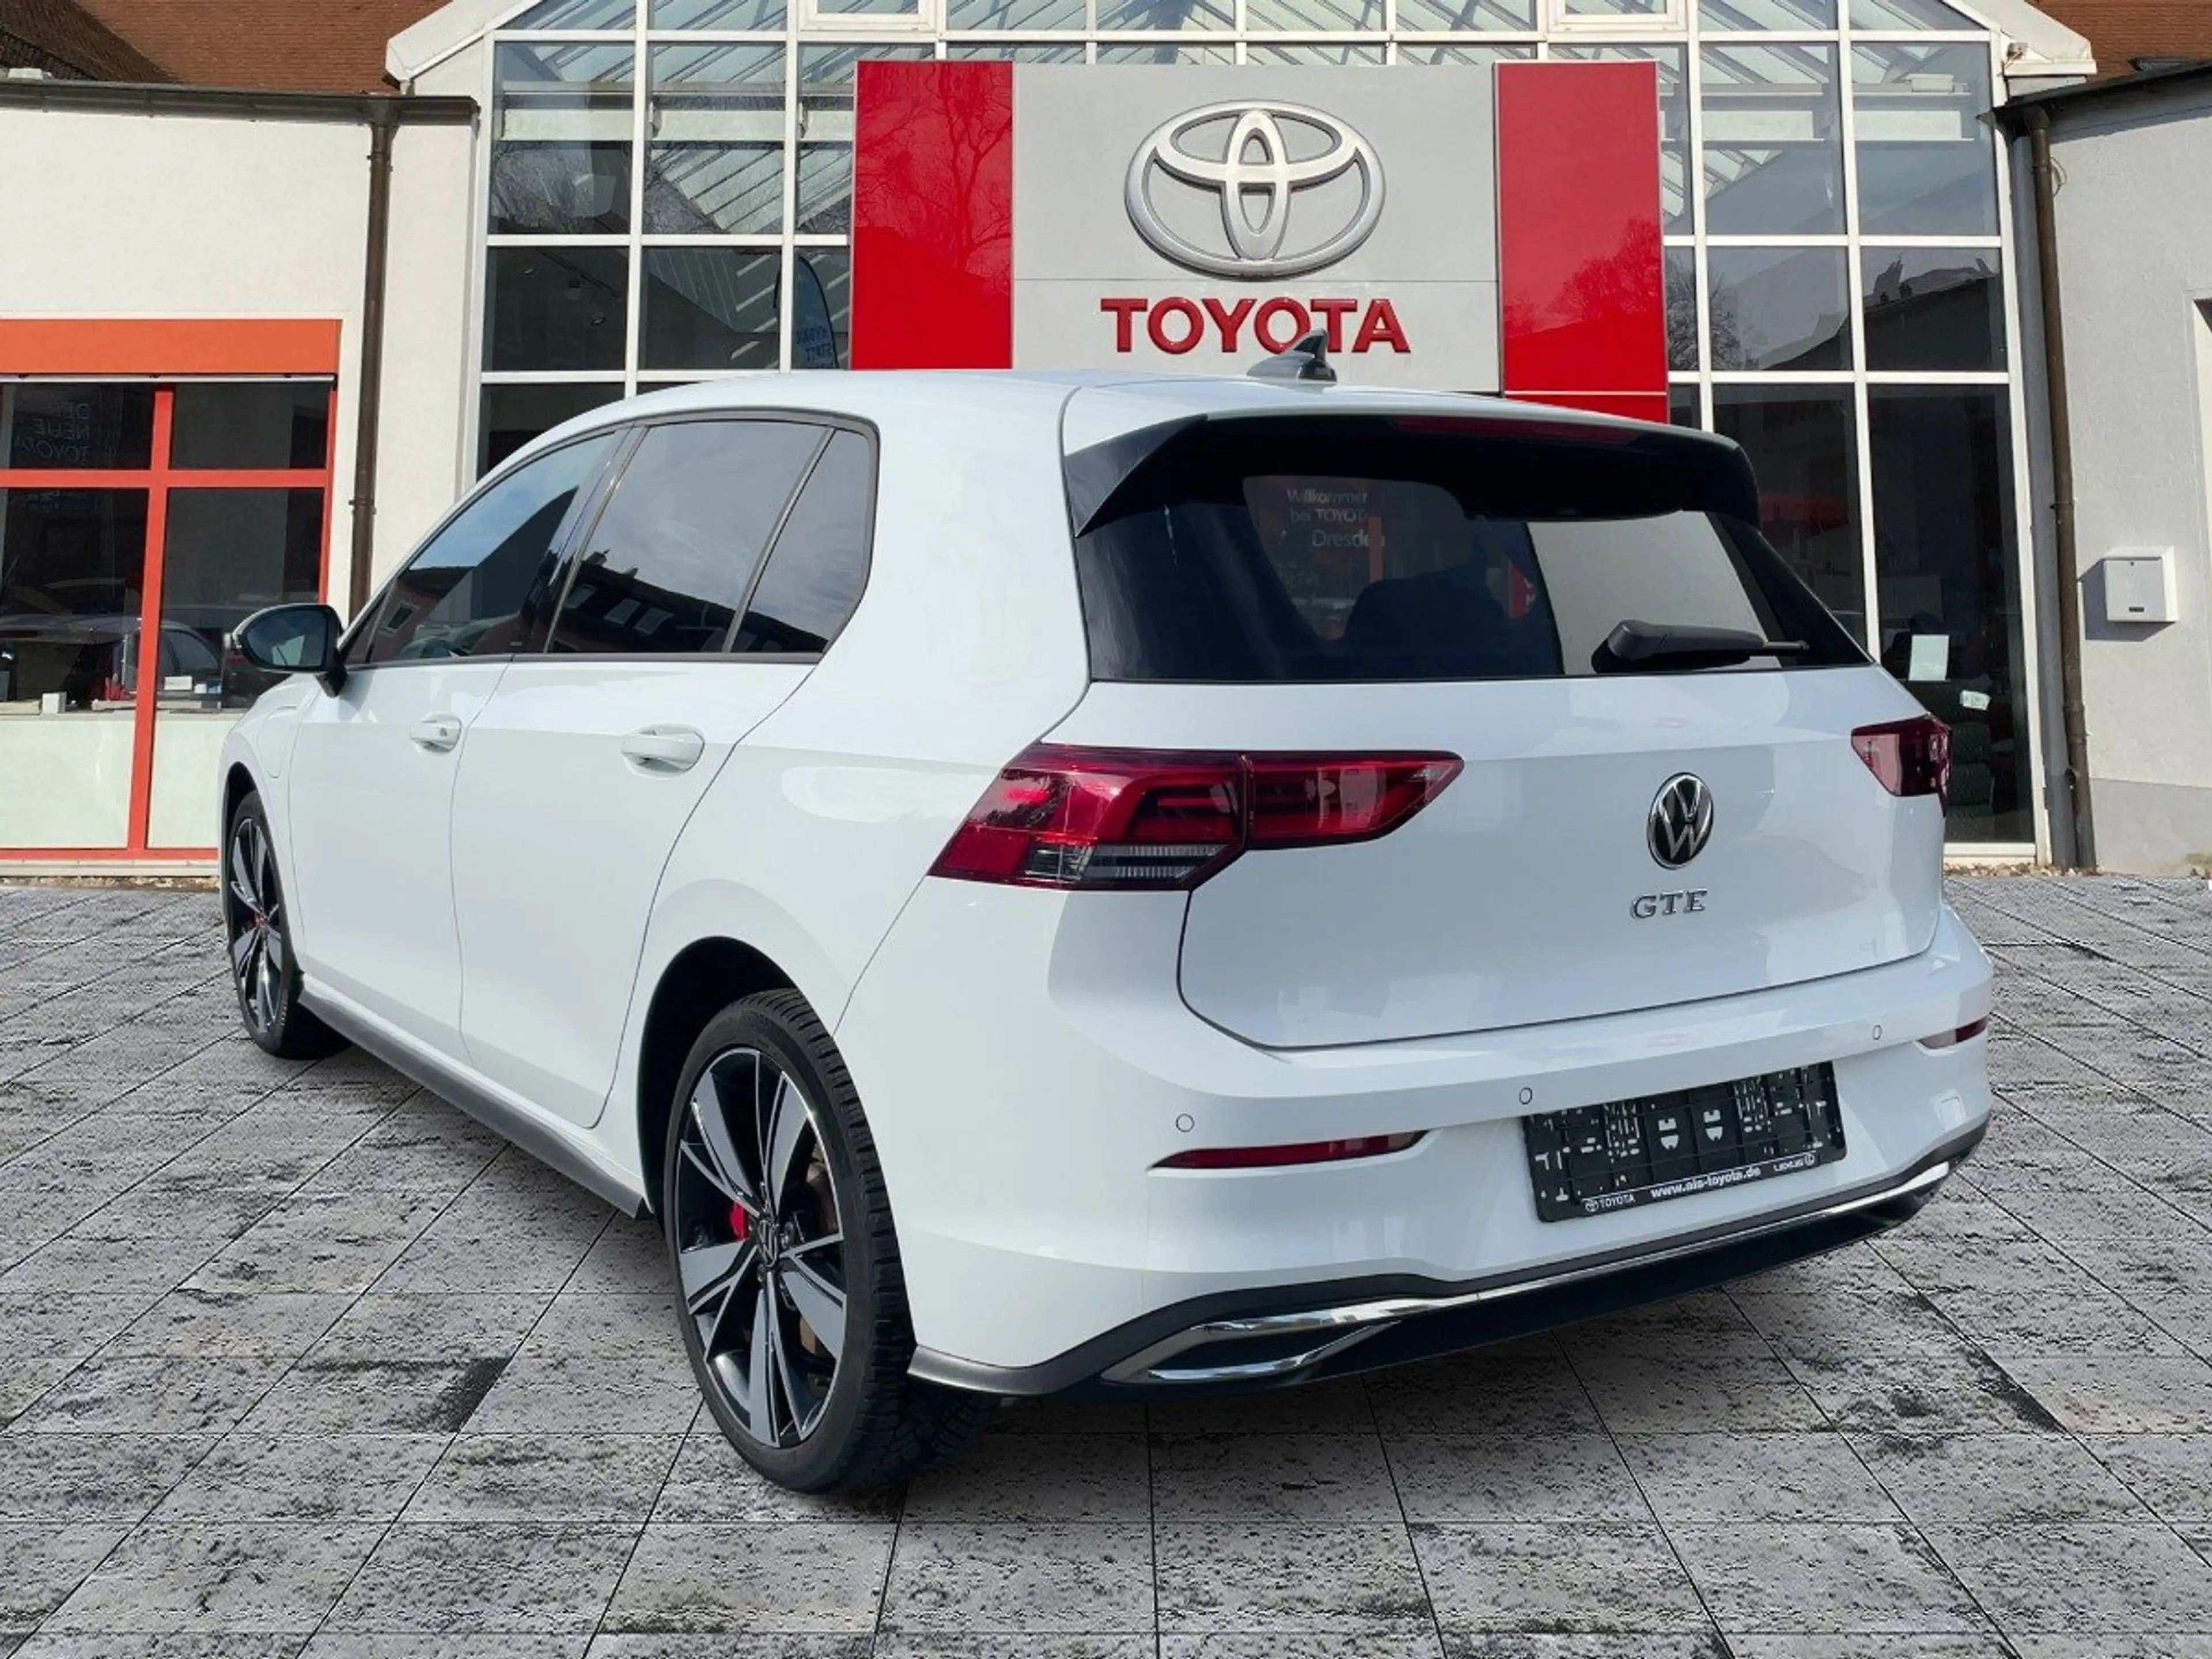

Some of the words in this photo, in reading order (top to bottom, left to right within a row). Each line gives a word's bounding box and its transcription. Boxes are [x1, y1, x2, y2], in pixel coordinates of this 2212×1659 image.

[1100, 297, 1411, 354] TOYOTA
[1315, 509, 1368, 523] TOYOT
[1631, 888, 1708, 919] GTE
[1600, 1194, 1636, 1209] TOYOTA
